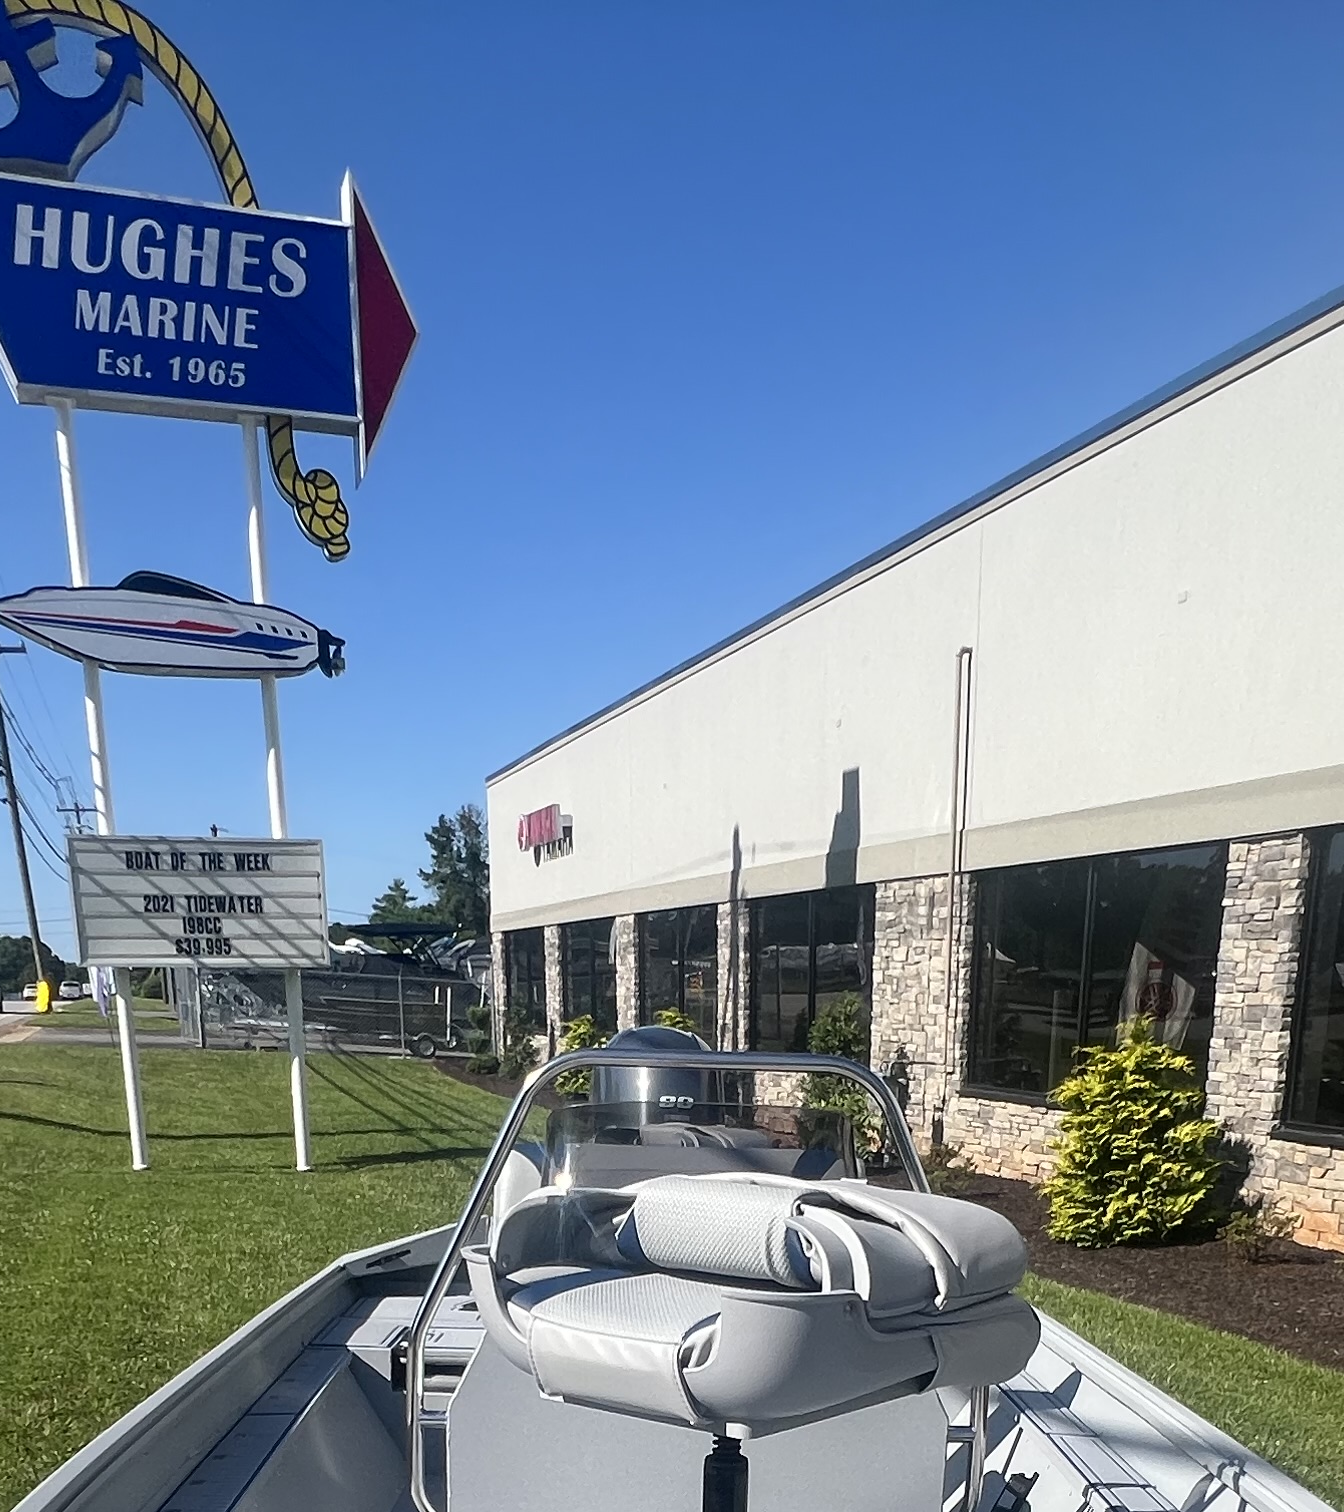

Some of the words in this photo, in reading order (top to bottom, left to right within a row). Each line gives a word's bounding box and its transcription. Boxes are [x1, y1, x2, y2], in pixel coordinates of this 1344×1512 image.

[13, 204, 307, 298] HUGHES
[75, 289, 259, 349] MARINE
[97, 348, 152, 378] Est.
[169, 356, 246, 388] 1965
[125, 851, 160, 870] BOAT
[171, 852, 187, 870] OF
[199, 853, 224, 870] THE
[234, 853, 270, 871] WEEK
[143, 895, 175, 913] 2021
[184, 895, 264, 914] TIDEWATER
[182, 916, 222, 934] 198CC
